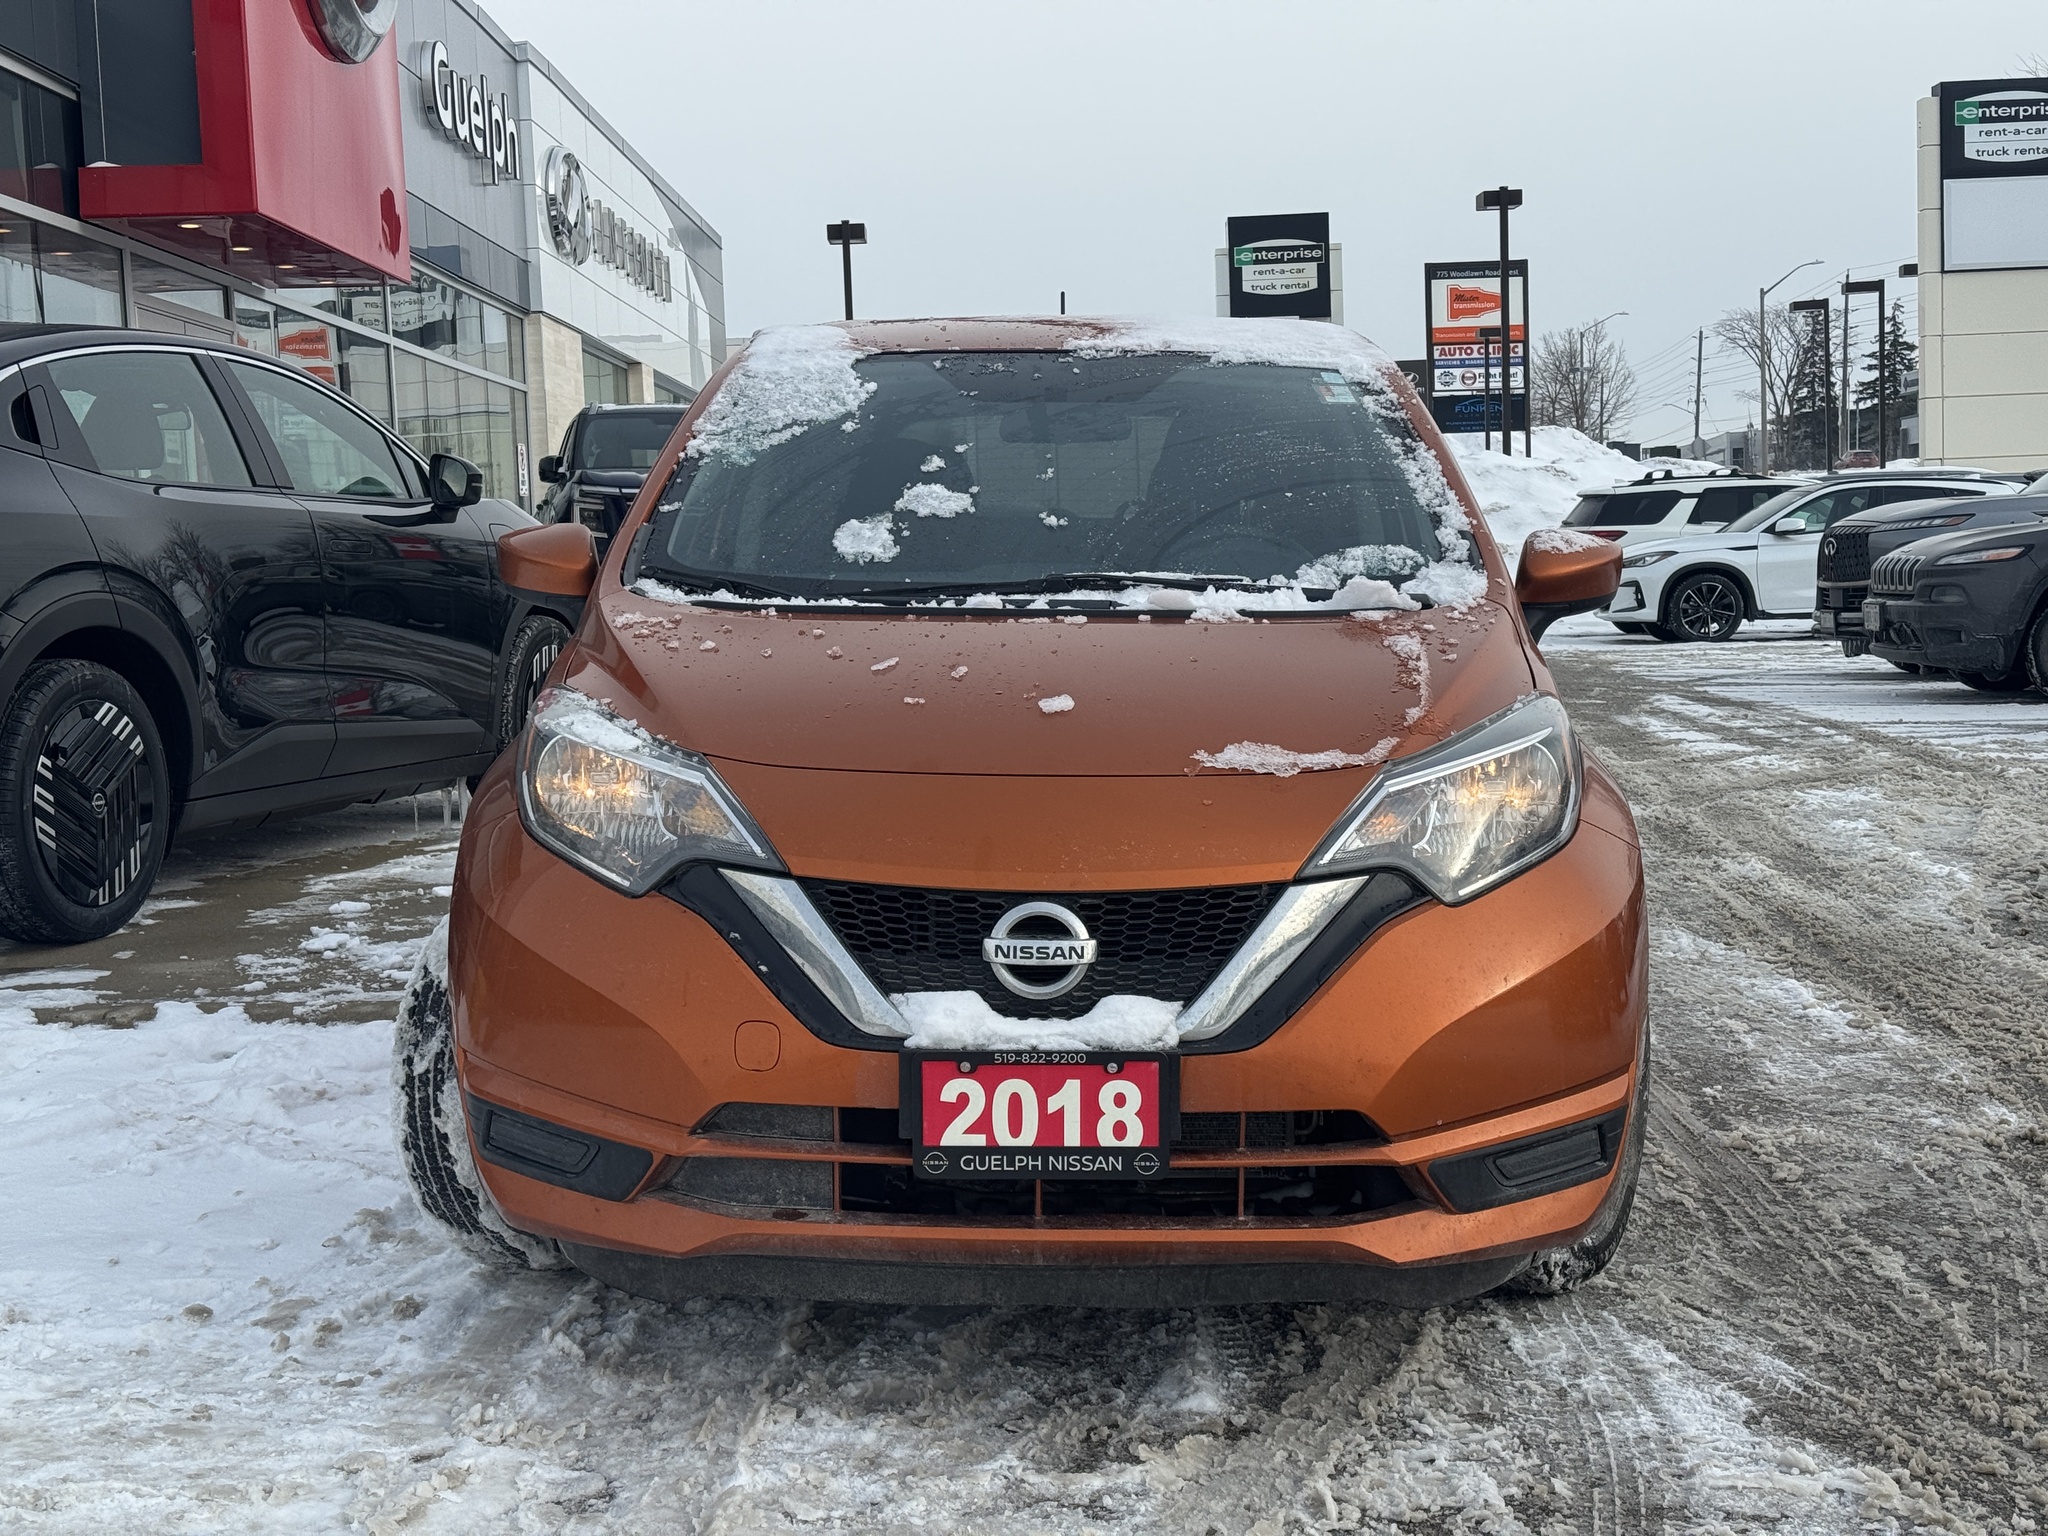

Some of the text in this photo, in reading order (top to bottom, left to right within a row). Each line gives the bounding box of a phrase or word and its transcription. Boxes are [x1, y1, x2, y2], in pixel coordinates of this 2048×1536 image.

[424, 40, 521, 186] Guelph
[1979, 127, 2047, 137] rent-a-car
[1975, 146, 2010, 157] truck
[1239, 247, 1322, 262] enterprise
[1253, 267, 1306, 276] rent-a-car
[1450, 269, 1484, 278] Woodlawn
[1251, 281, 1310, 291] truck rental
[1453, 294, 1479, 302] Mister
[1453, 301, 1496, 309] transmission
[1438, 346, 1474, 357] AUTO
[994, 944, 1085, 961] NISSAN
[993, 1053, 1086, 1064] 519-822-9200
[939, 1078, 1144, 1147] 2018
[960, 1155, 1122, 1171] GUELPH NISSAN
